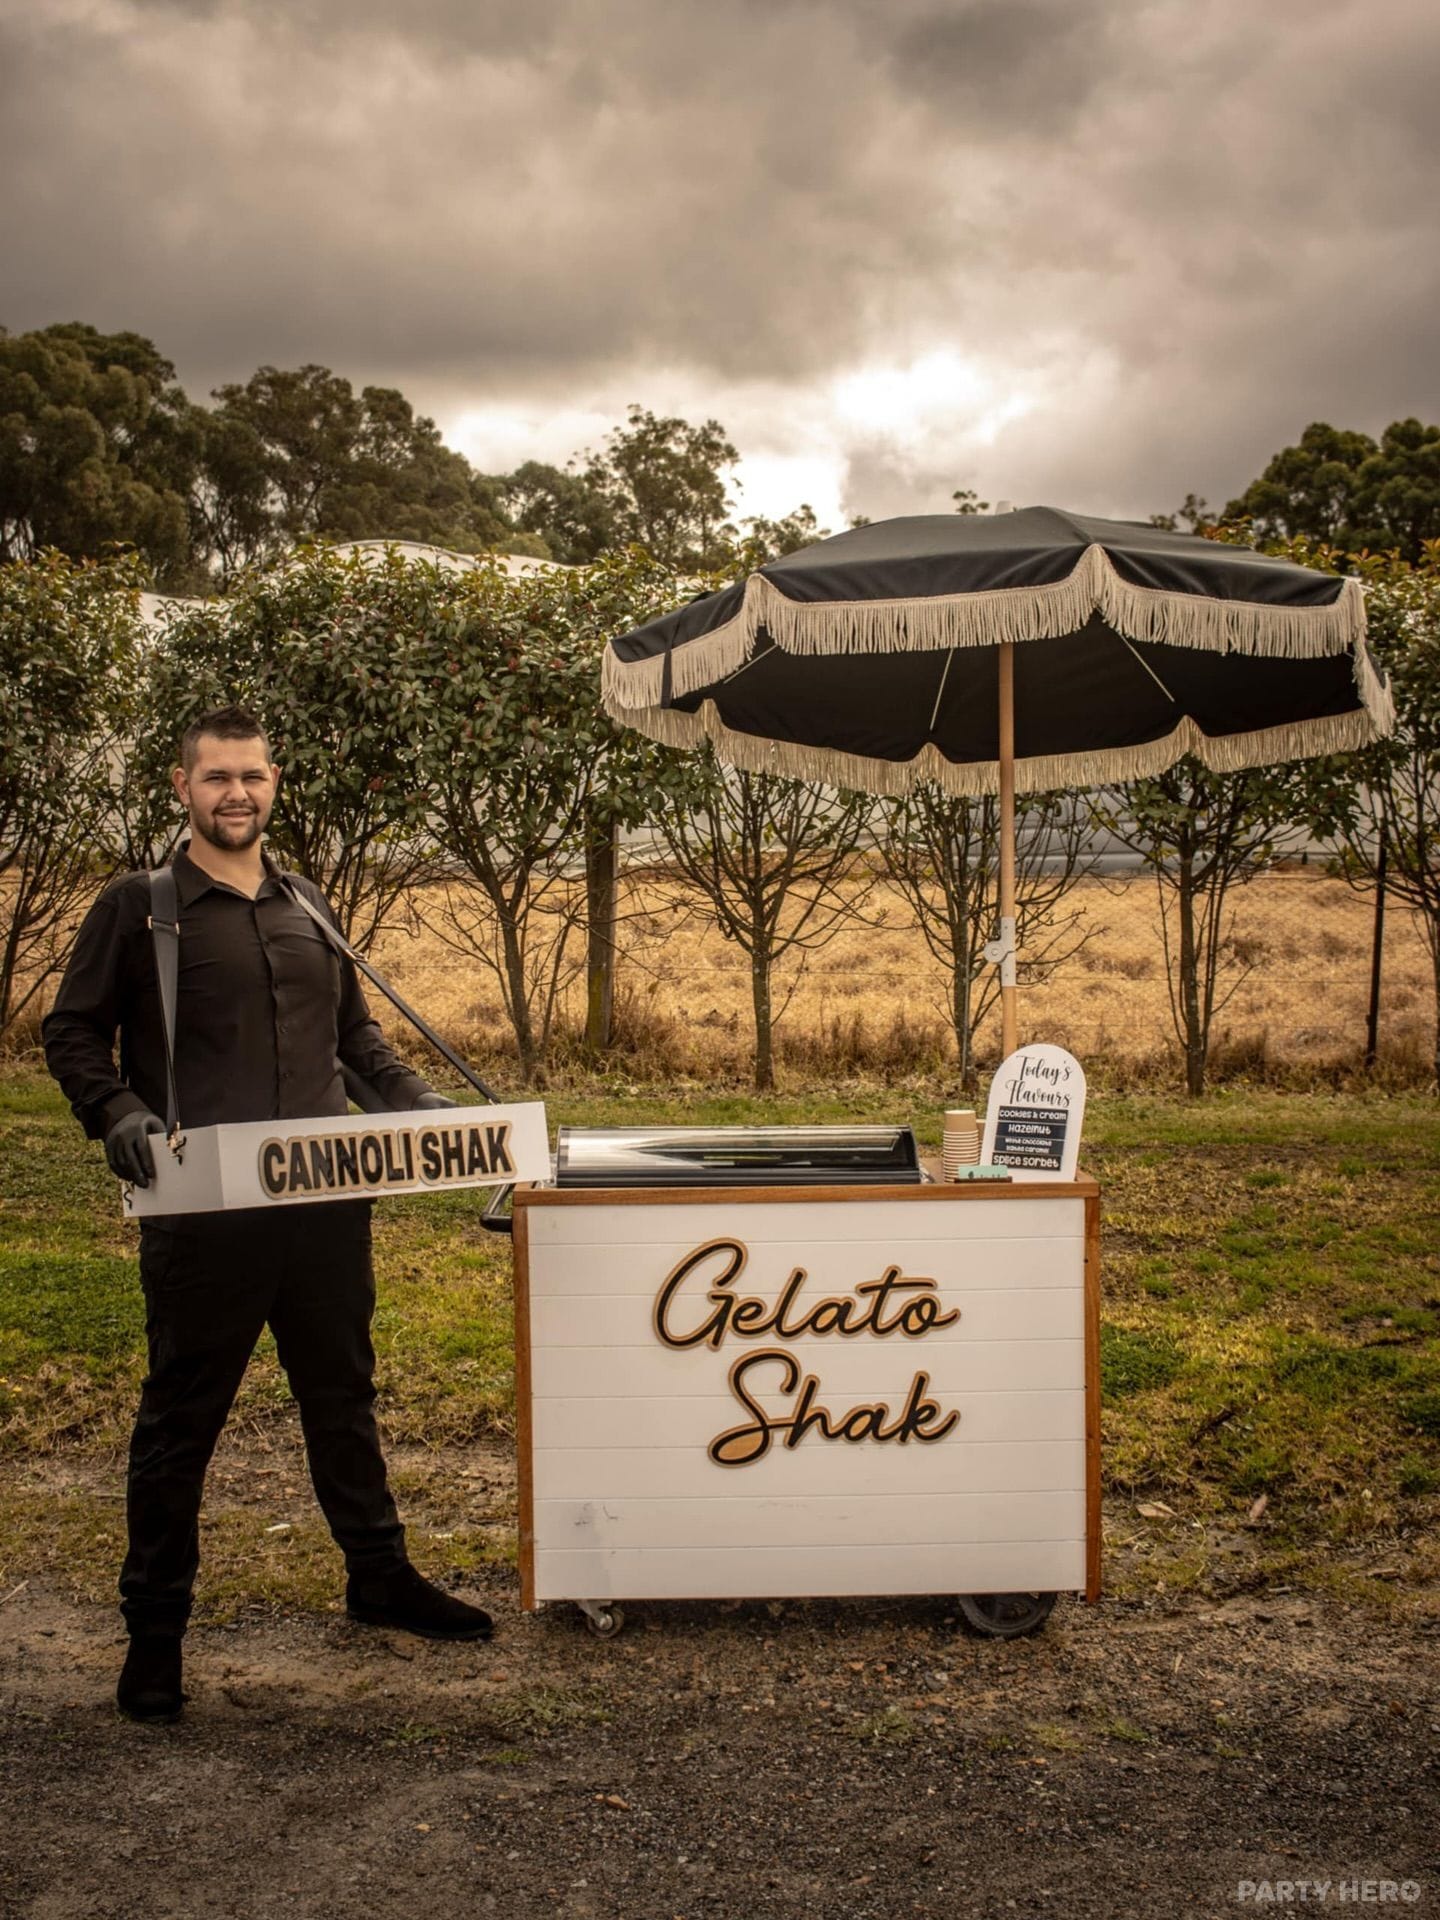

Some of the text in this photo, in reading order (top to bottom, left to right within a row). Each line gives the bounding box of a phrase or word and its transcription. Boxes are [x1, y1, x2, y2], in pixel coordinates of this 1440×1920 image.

[1005, 1079, 1071, 1108] Flavours
[1016, 1055, 1072, 1086] Today's
[262, 1124, 513, 1195] CANNOLI SHAK
[655, 1240, 959, 1349] Gelato
[710, 1351, 958, 1466] Shak
